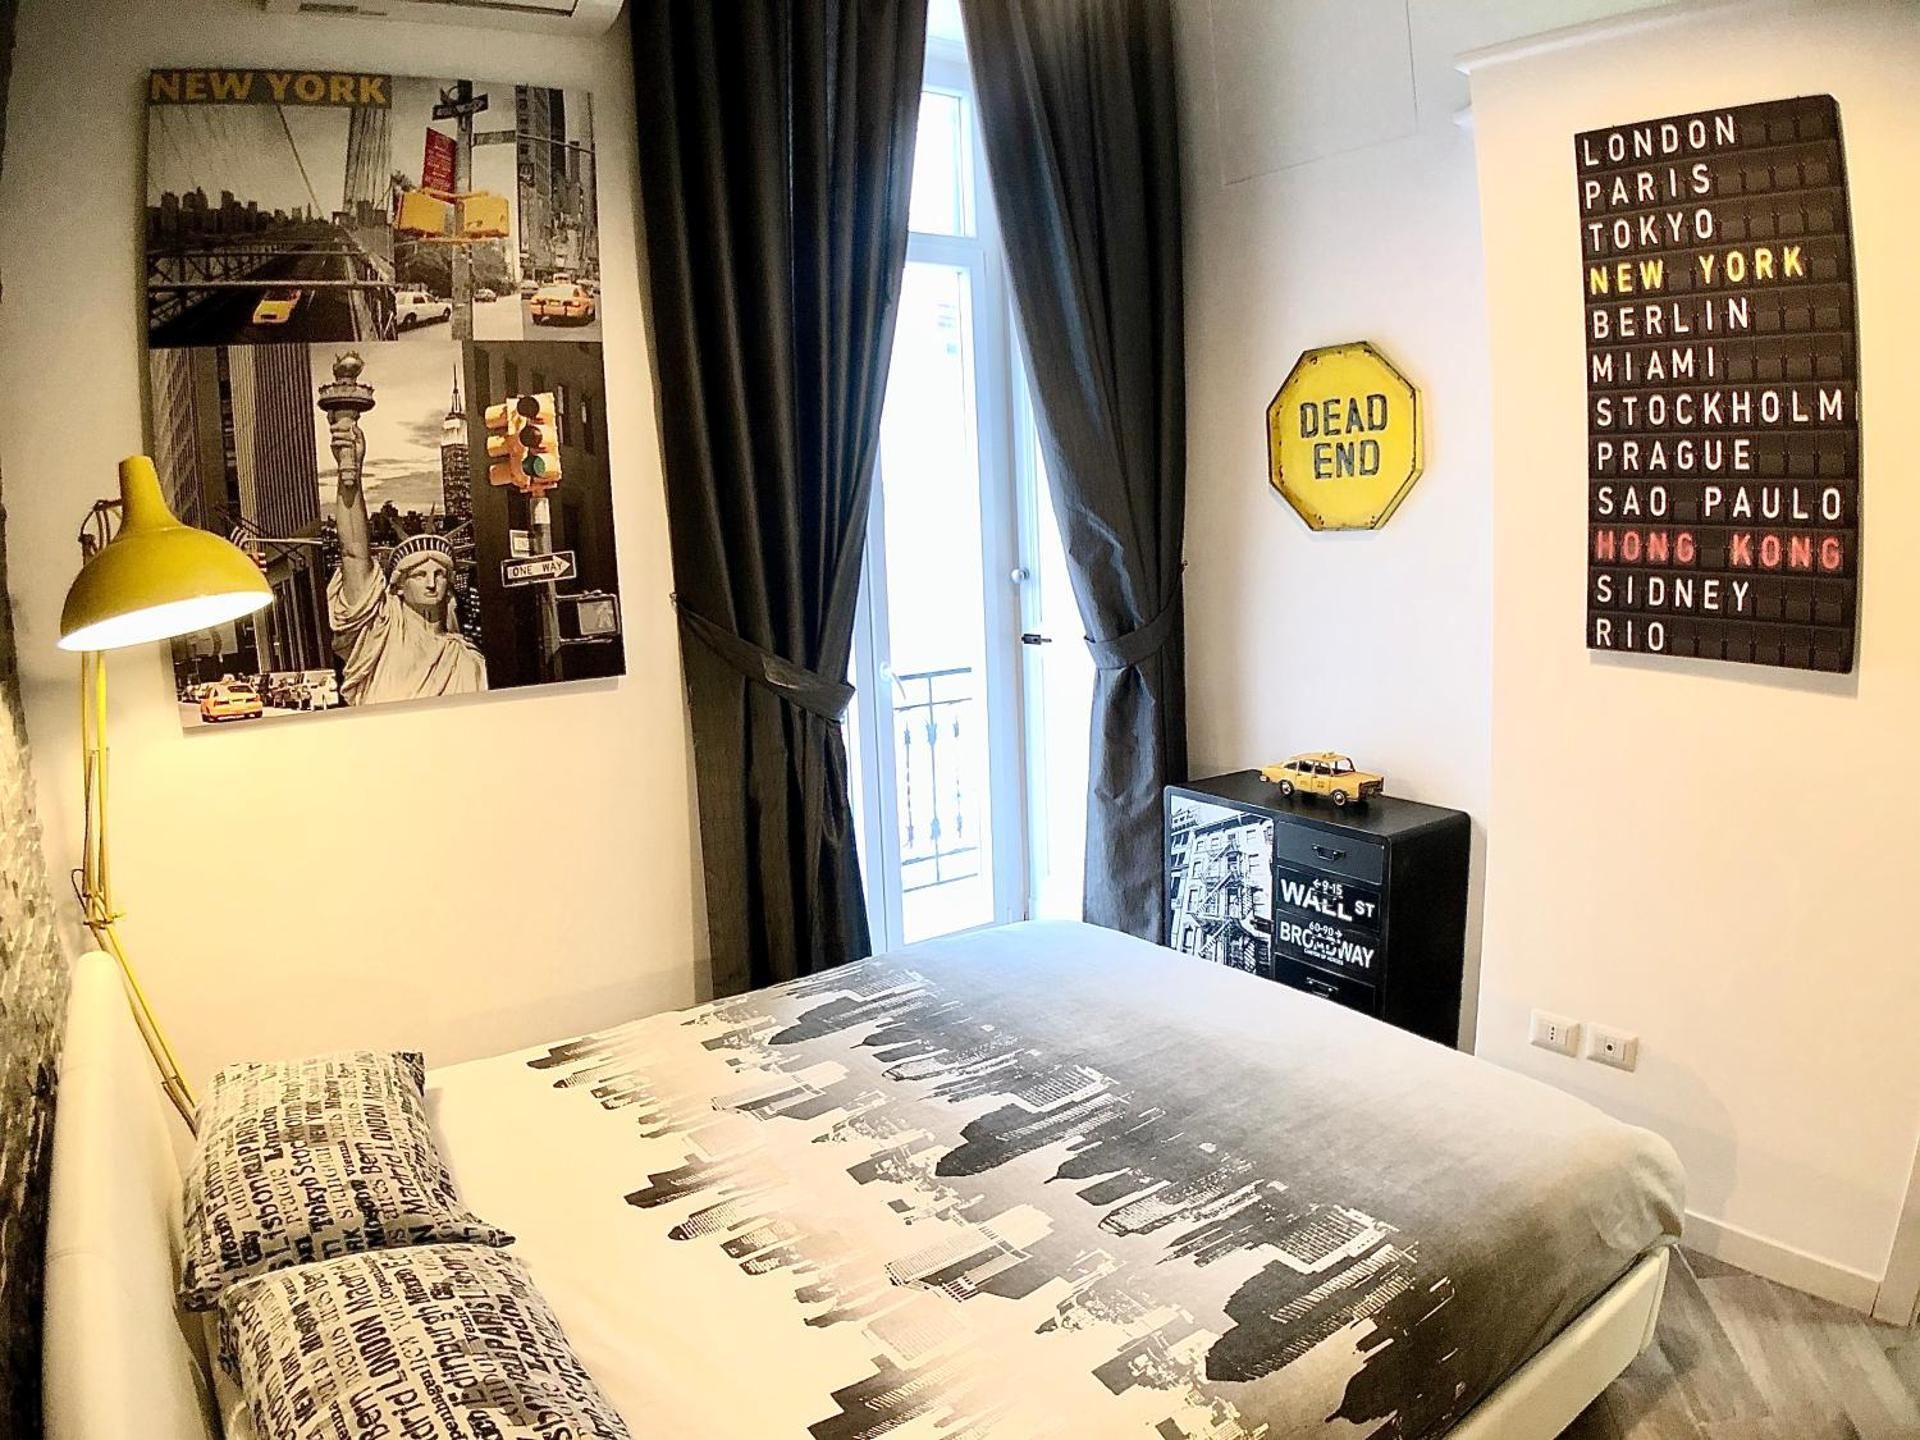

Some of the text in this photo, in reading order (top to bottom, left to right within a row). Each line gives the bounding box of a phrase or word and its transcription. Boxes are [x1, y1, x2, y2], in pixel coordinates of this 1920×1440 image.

[151, 72, 386, 104] NEW YORK
[1583, 114, 1735, 167] LONDON
[1585, 163, 1710, 209] PARIS
[1588, 208, 1713, 252] TOKYO
[1589, 246, 1803, 295] NEW YORK
[1593, 297, 1748, 339] BERLIN
[1592, 347, 1714, 383] MIAMI
[1300, 393, 1388, 439] DEAD
[1596, 389, 1843, 427] STOCKHOLM
[1314, 439, 1380, 480] END
[1598, 439, 1750, 471] PRAGUE
[1598, 485, 1840, 520] SAO PAULO
[512, 561, 563, 577] ONE WAY
[1596, 530, 1841, 570] HONG KONG
[1597, 575, 1749, 612] SIDNEY
[1596, 618, 1664, 651] RIO
[1281, 879, 1375, 922] WALL ST
[305, 1101, 323, 1122] YORK
[363, 1104, 394, 1151] LONDON
[236, 1118, 260, 1156] PARIS
[259, 1106, 283, 1162] London
[308, 1124, 329, 1144] NEW
[336, 1139, 357, 1177] Vienna
[355, 1142, 382, 1174] Bern
[298, 1177, 334, 1233] Tokyo
[382, 1155, 429, 1215] Madrid
[331, 1262, 378, 1315] Madrid
[452, 1305, 480, 1343] Venice
[465, 1302, 517, 1351] PARIS
[496, 1293, 551, 1373] London
[280, 1347, 305, 1394] YORK
[350, 1314, 408, 1392] LONDON
[412, 1305, 488, 1408] Edinburgh
[289, 1387, 318, 1428] NEW
